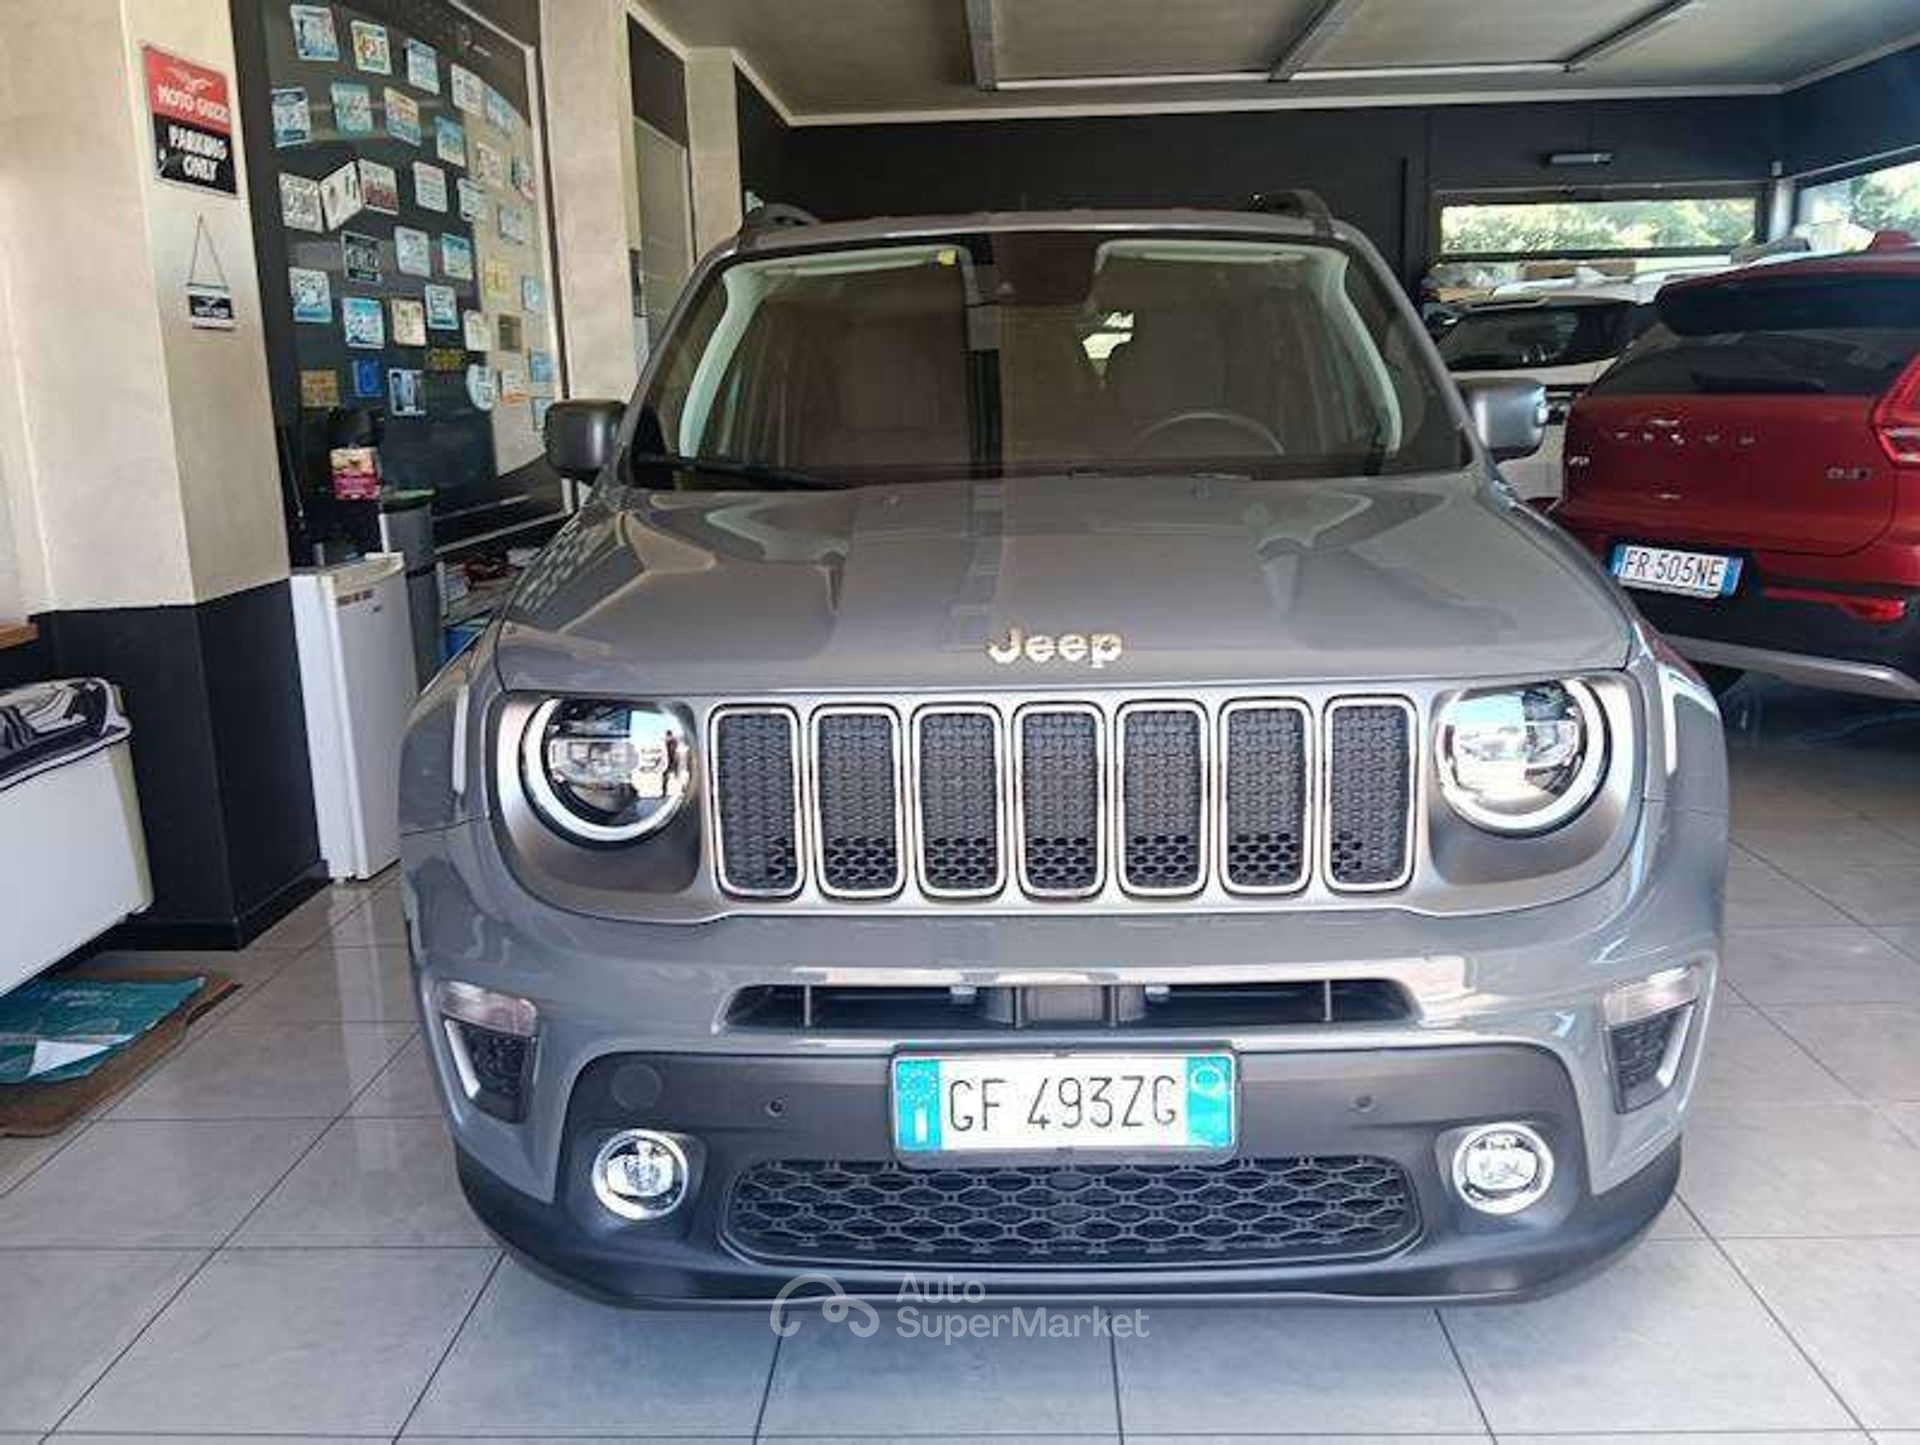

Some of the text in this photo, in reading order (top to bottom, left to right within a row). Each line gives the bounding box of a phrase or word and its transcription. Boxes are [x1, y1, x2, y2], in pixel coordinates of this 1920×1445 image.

[1625, 550, 1650, 577] FR
[987, 626, 1122, 669] Jeep
[949, 1074, 1177, 1132] GF 493ZG
